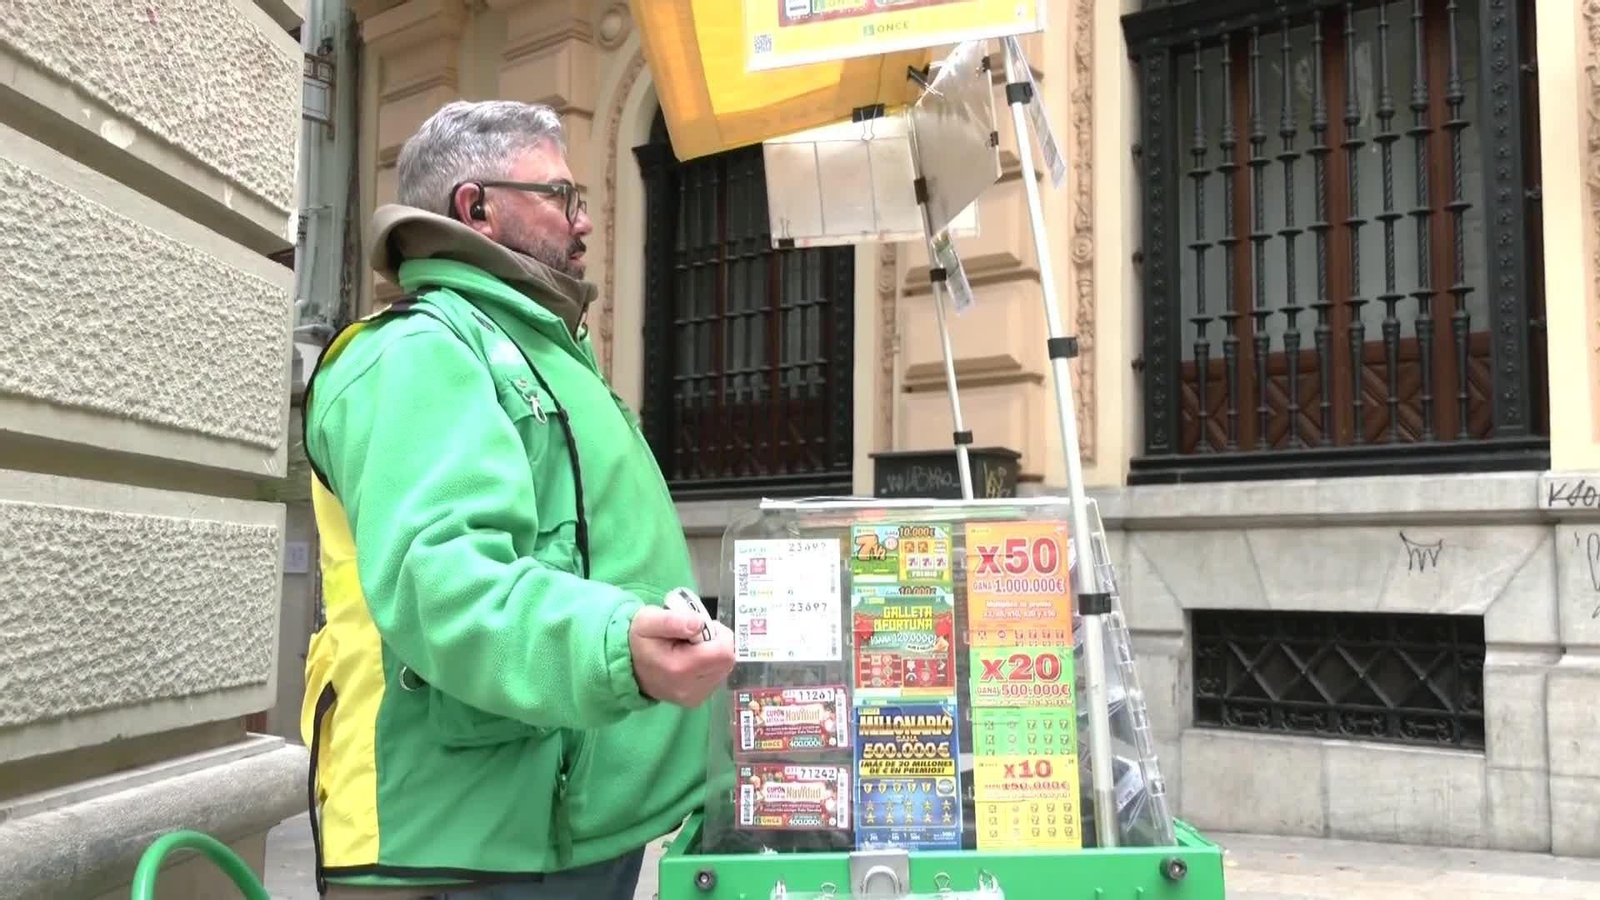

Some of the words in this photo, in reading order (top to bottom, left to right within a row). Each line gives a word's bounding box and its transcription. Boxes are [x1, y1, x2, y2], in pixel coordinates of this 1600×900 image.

[877, 21, 909, 33] ONCE
[899, 526, 936, 537] 10.000€
[977, 537, 1057, 574] x50
[973, 582, 992, 590] GANA
[995, 579, 1063, 592] 1.000.000€
[789, 602, 828, 612] 23697
[884, 606, 933, 618] GALLETA
[884, 619, 933, 631] FORTUNA
[981, 653, 1060, 681] x20
[1001, 684, 1070, 696] 500.000€
[766, 709, 784, 717] CUPÓN
[786, 708, 820, 721] Navidad
[859, 715, 954, 736] MILLONARIO
[863, 742, 951, 759] 500.000€
[801, 768, 835, 778] 71242
[1003, 760, 1052, 778] x10
[767, 786, 785, 794] CUPÓN
[786, 786, 820, 799] Navidad
